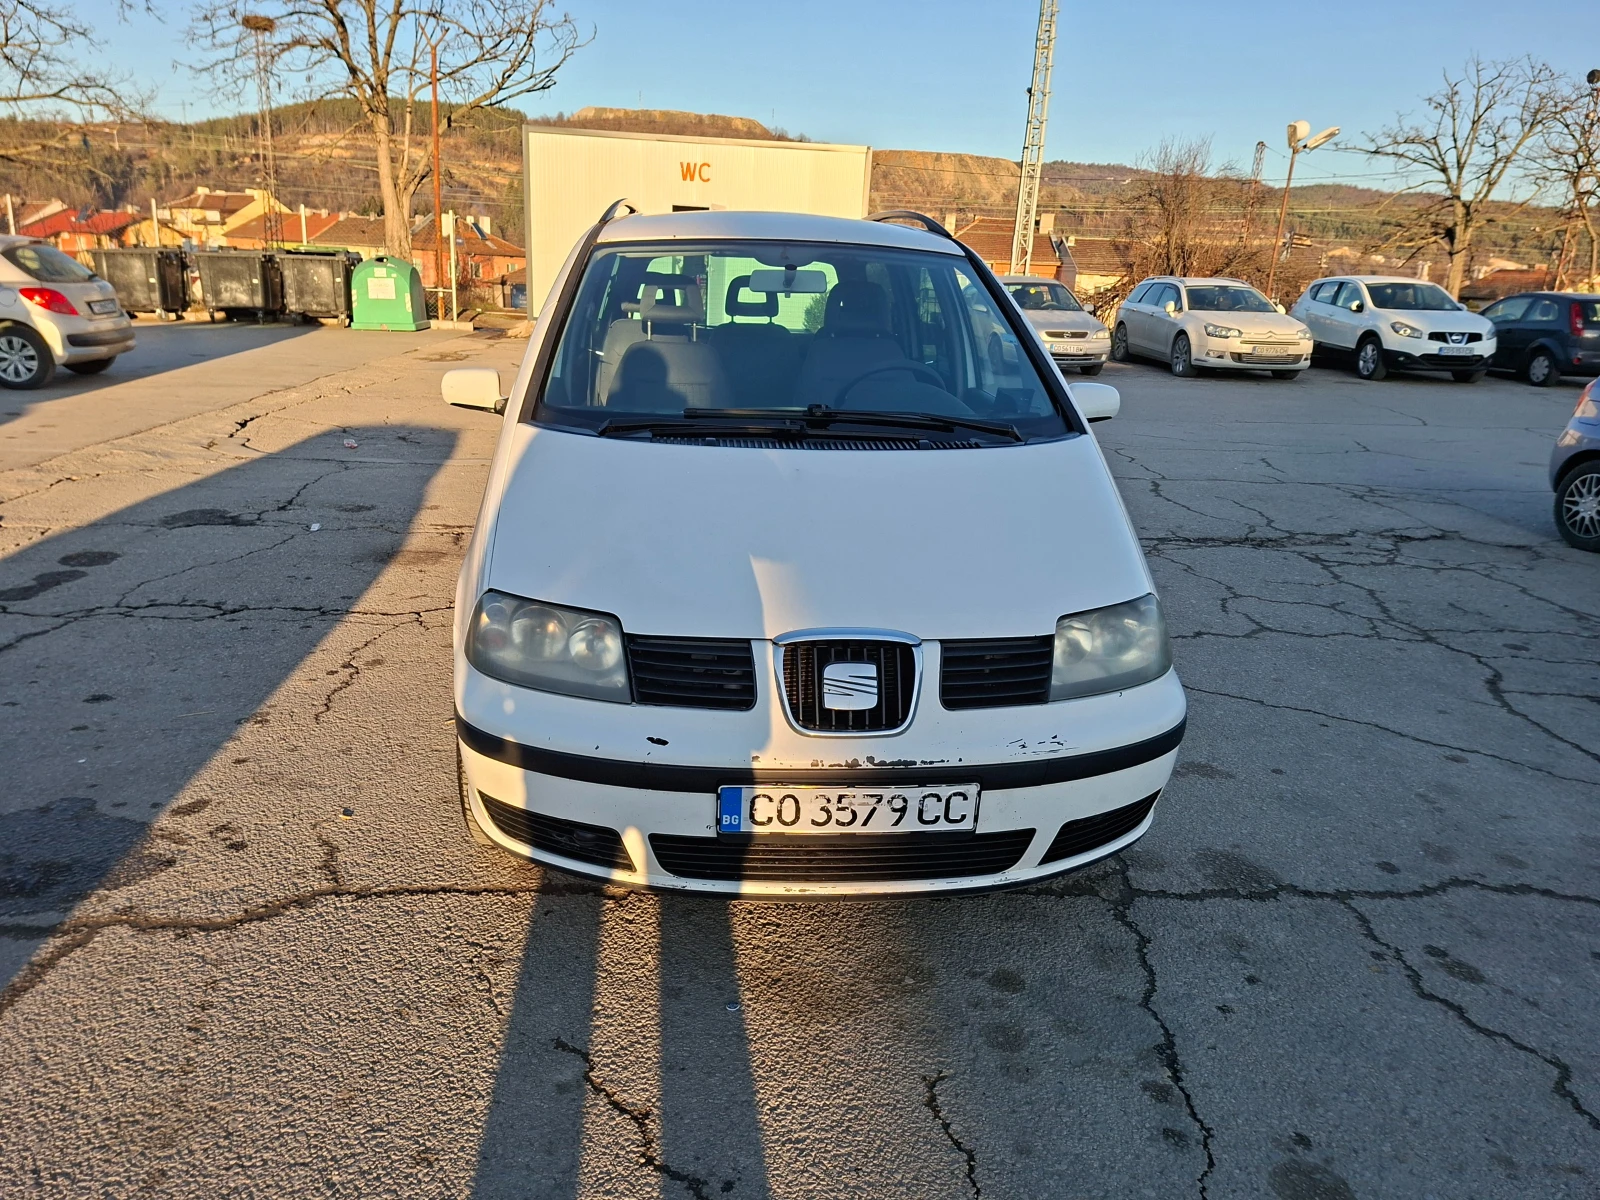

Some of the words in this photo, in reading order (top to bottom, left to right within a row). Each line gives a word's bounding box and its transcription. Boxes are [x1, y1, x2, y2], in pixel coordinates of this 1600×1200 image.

[680, 162, 710, 182] WC
[748, 793, 801, 827] CO
[810, 793, 908, 827] 3579
[917, 791, 969, 826] CC
[722, 814, 739, 825] BG
